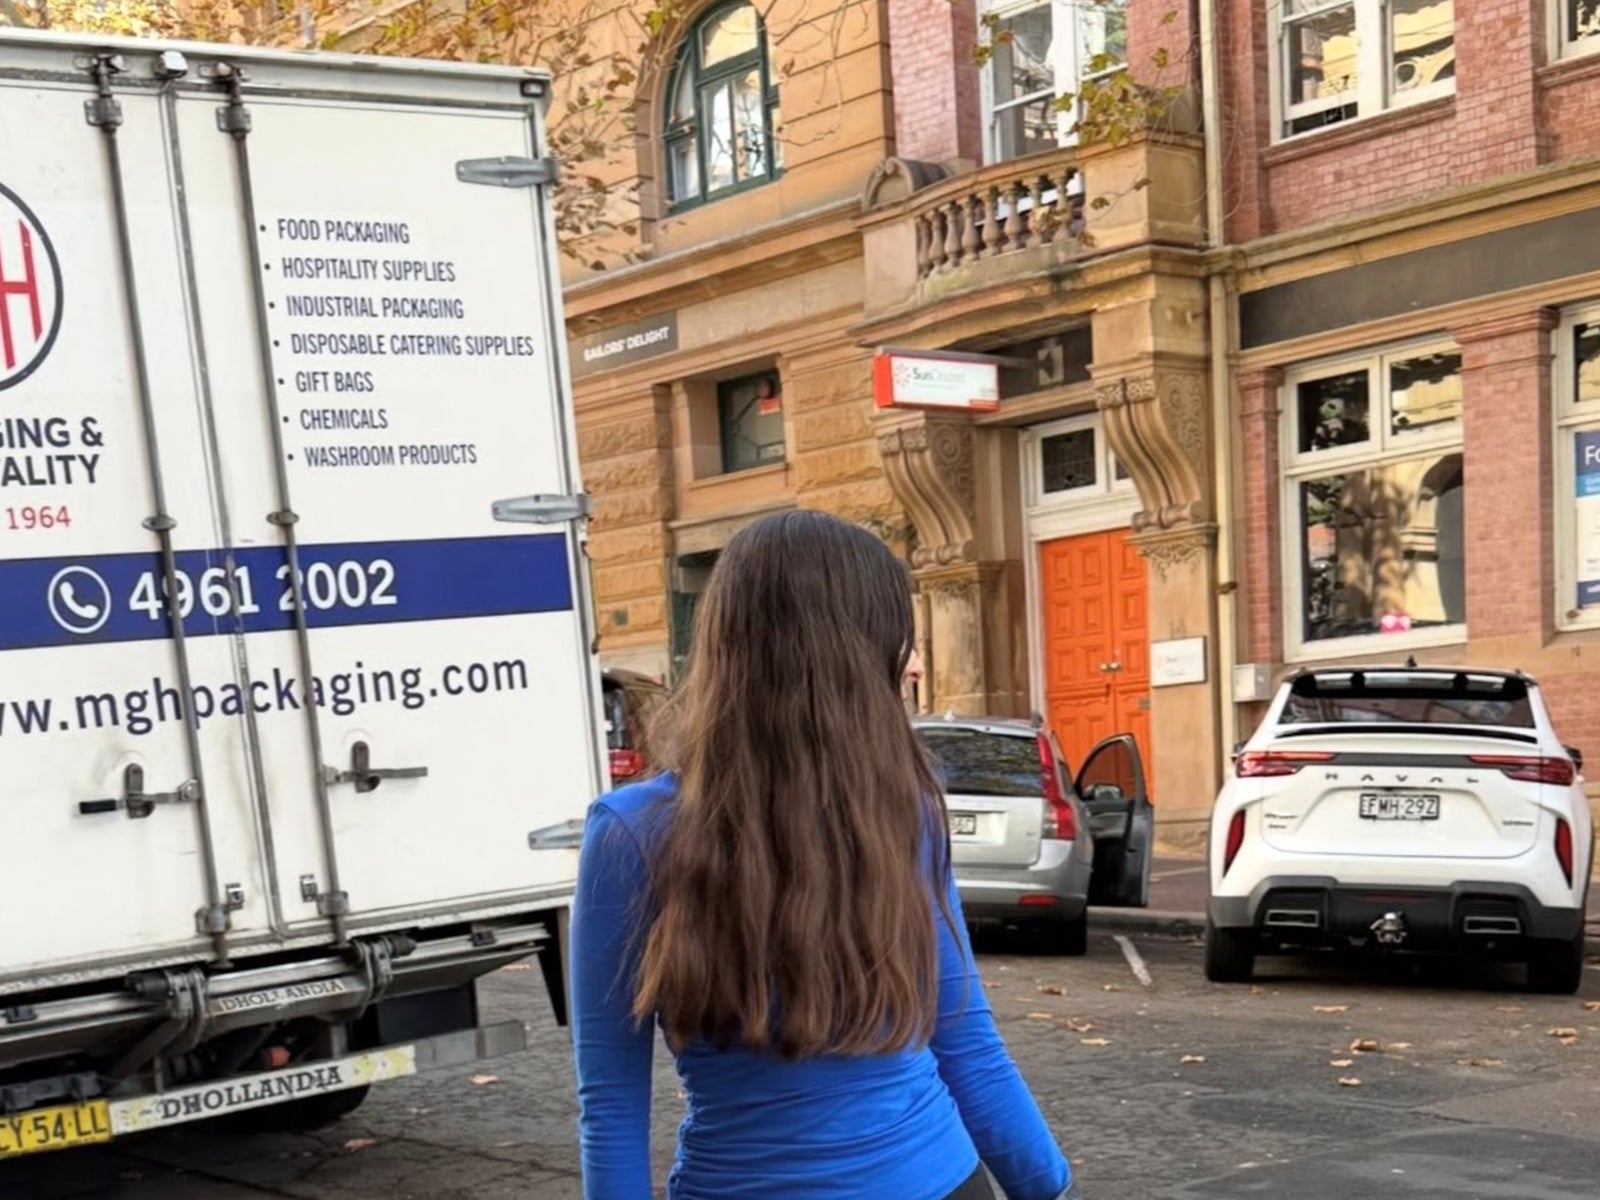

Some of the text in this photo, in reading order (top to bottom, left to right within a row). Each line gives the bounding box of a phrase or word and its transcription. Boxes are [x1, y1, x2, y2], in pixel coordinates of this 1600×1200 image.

[277, 218, 410, 244] FOOD PACKAGING
[282, 257, 456, 282] HOSPITALITY SUPPLIES
[286, 295, 464, 319] INDUSTRIAL PACKAGING
[291, 333, 534, 356] DISPOSABLE CATERING SUPPLIES
[626, 326, 669, 350] DELIGHT
[295, 371, 374, 393] GIFT BAGS
[300, 408, 388, 430] CHEMICALS
[0, 416, 105, 449] ING &
[304, 444, 477, 467] WASHROOM PRODUCTS
[6, 505, 71, 530] 1964
[129, 559, 398, 620] 4961 2002
[0, 659, 529, 736] w.mghpackaging.com
[222, 981, 344, 1010] DHOLLANDIA
[159, 1066, 344, 1120] DHOLLANDIA
